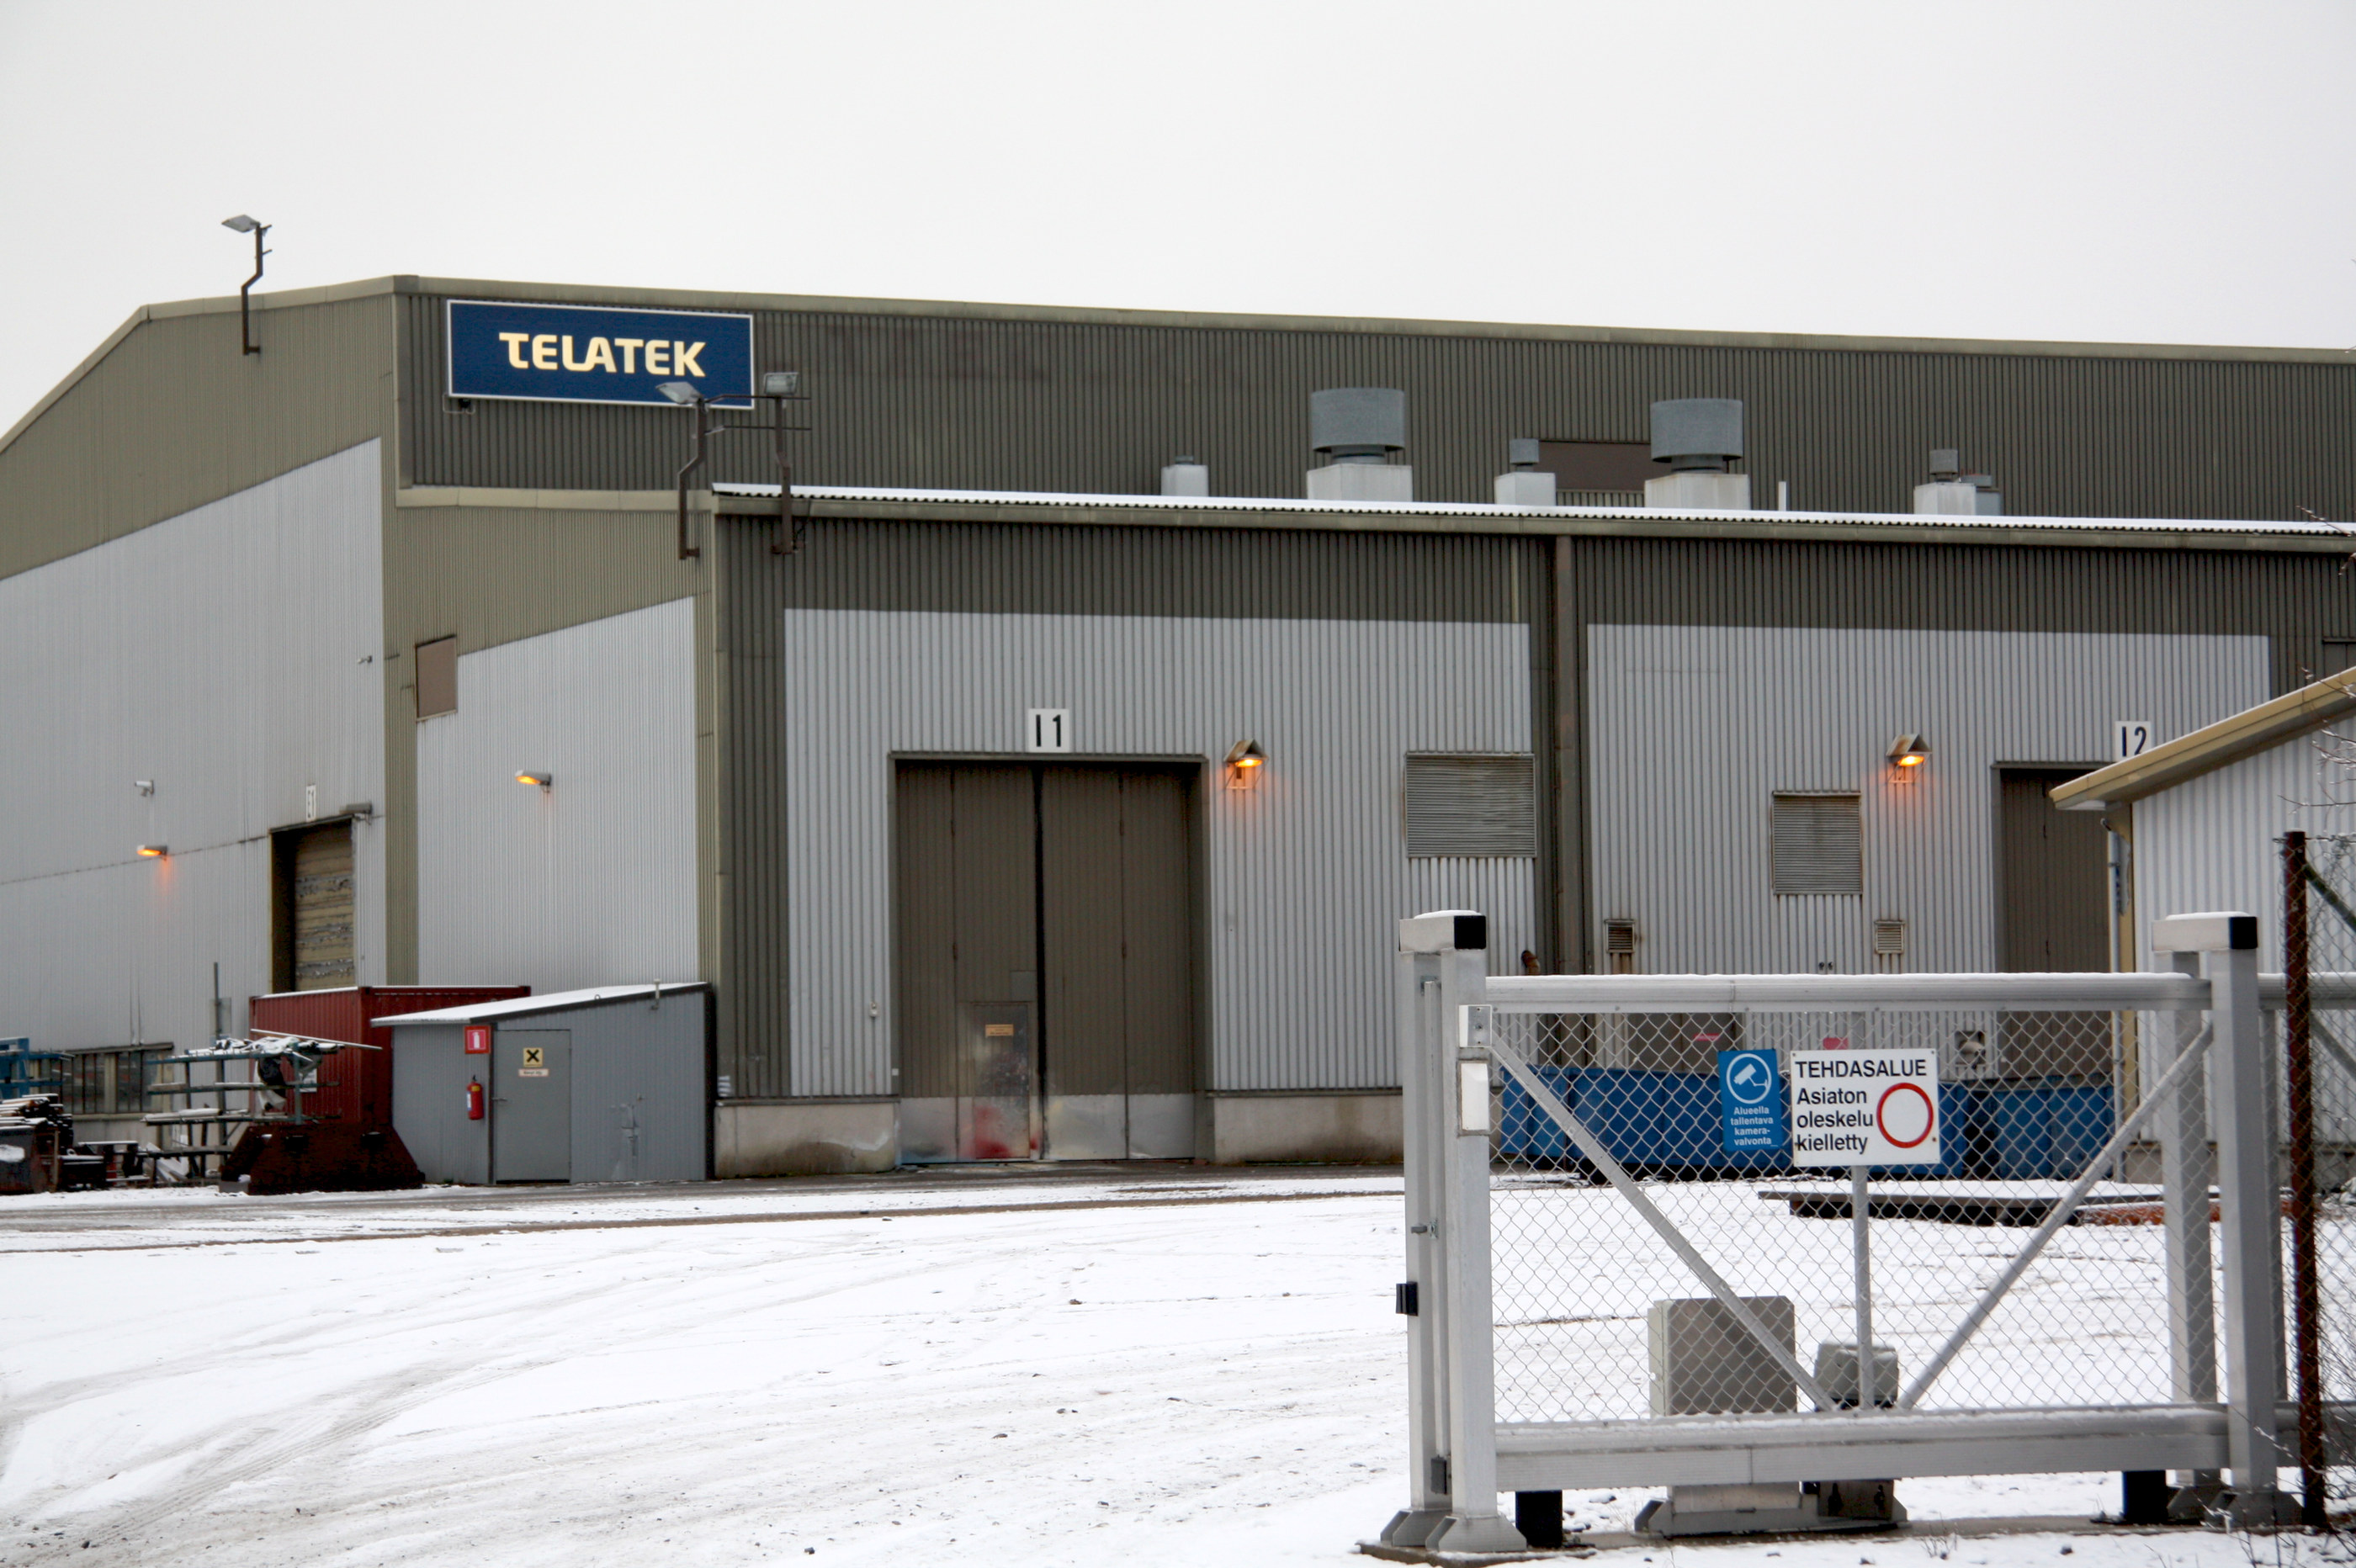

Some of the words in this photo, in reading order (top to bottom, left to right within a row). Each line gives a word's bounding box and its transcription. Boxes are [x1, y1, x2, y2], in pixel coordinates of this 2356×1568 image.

[498, 331, 706, 378] TELATEK
[1794, 1059, 1927, 1078] TEHDASALUE
[1796, 1087, 1867, 1105] Asiaton
[1733, 1105, 1770, 1115] Alueella
[1796, 1110, 1874, 1128] oleskelu
[1730, 1116, 1774, 1126] tallentava
[1734, 1127, 1770, 1136] kamera-
[1734, 1136, 1772, 1146] valvonta
[1796, 1133, 1868, 1155] kielletty
